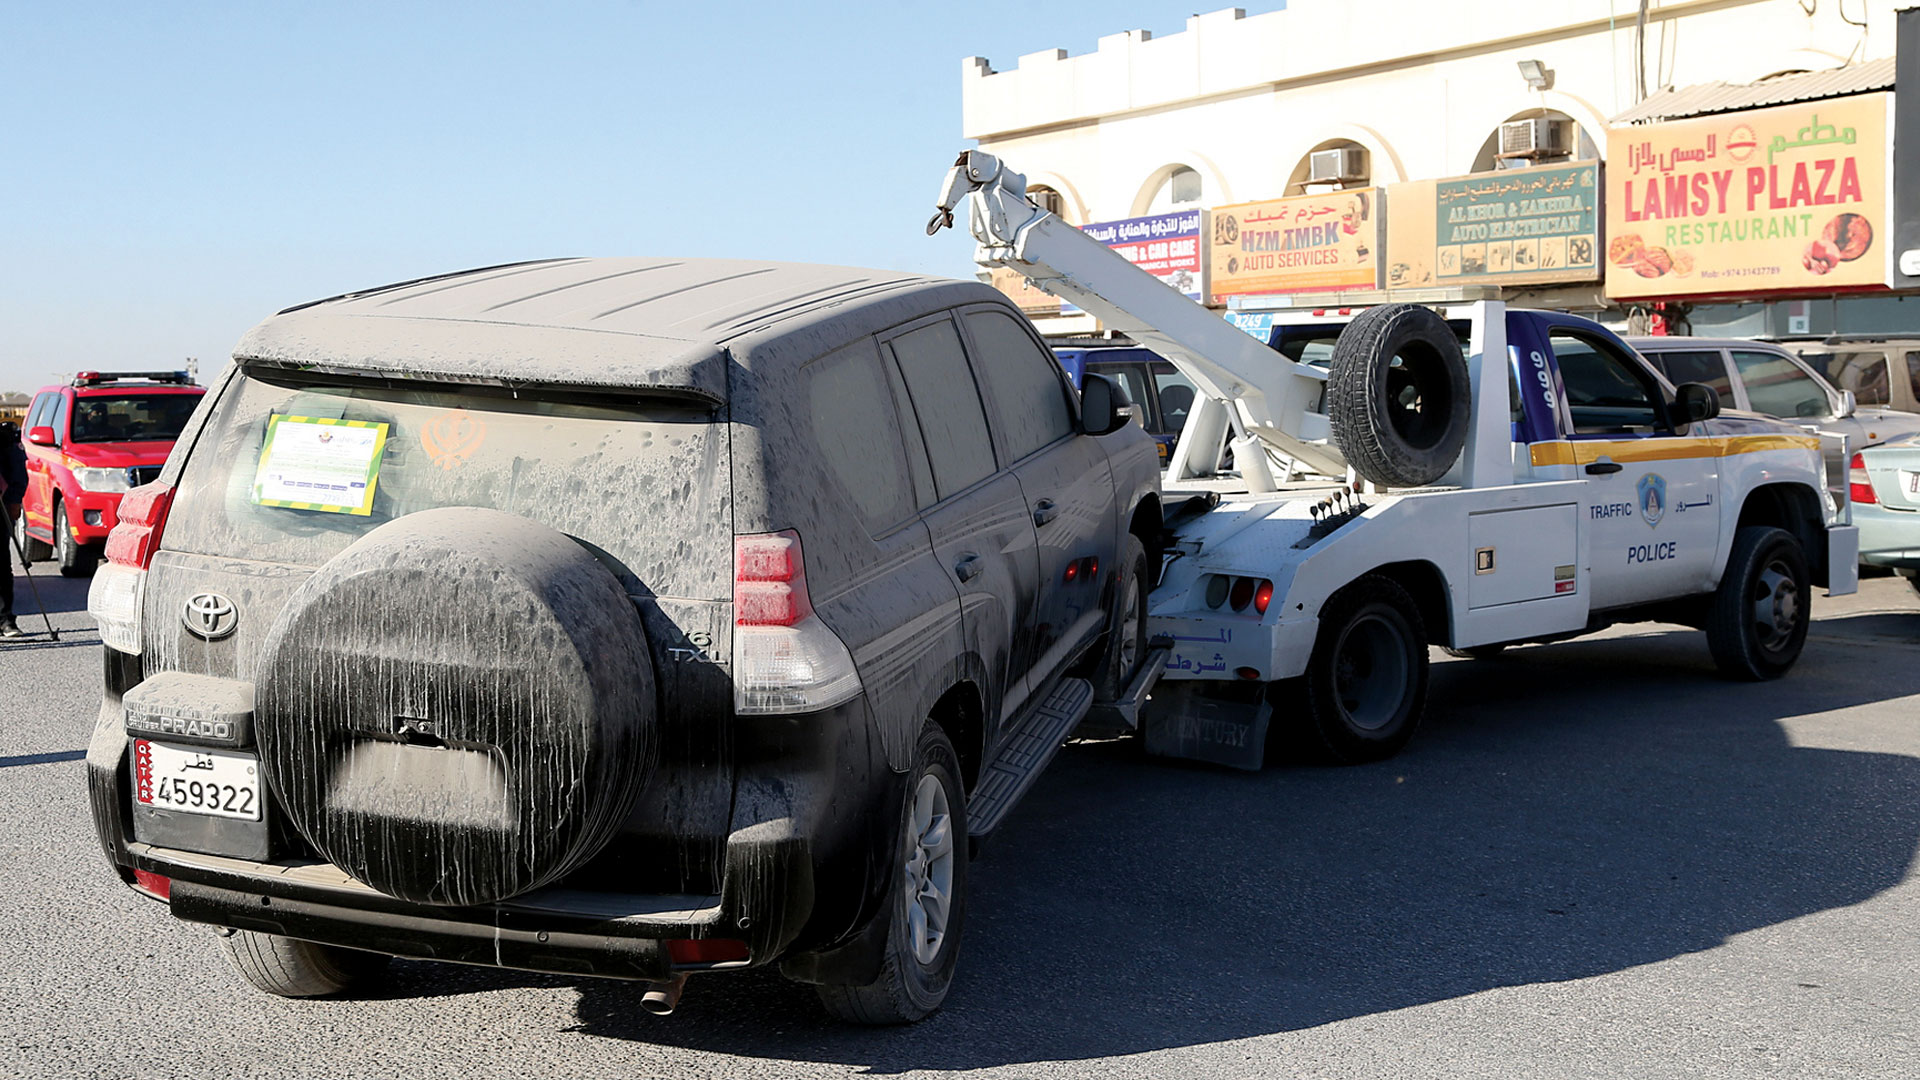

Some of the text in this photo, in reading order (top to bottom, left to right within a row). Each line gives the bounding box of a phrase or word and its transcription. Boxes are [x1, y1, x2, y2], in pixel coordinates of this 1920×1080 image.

[1768, 115, 1856, 165] مطعم
[1628, 142, 1656, 175] بلازا
[1625, 157, 1863, 222] LAMSY PLAZA
[1295, 205, 1337, 224] حزم
[1448, 206, 1466, 223] AL
[1467, 202, 1506, 221] KHOR
[1508, 202, 1518, 217] &
[1178, 215, 1199, 234] الفوز
[1451, 215, 1581, 242] AUTO ELECTRICIAN
[1665, 214, 1813, 246] RESTAURANT
[1241, 221, 1340, 252] HZM TMBK
[1140, 247, 1148, 261] &
[1148, 242, 1168, 260] CAR
[1169, 239, 1196, 257] CARE
[1243, 249, 1338, 271] AUTO SERVICES
[1530, 351, 1556, 409] 999
[1590, 502, 1632, 520] TRAFFIC
[1627, 542, 1677, 565] POLICE
[1166, 653, 1226, 675] شرط
[160, 716, 229, 738] PRADO
[138, 745, 149, 799] QATAR
[178, 752, 214, 772] قطر
[158, 777, 254, 815] 459322
